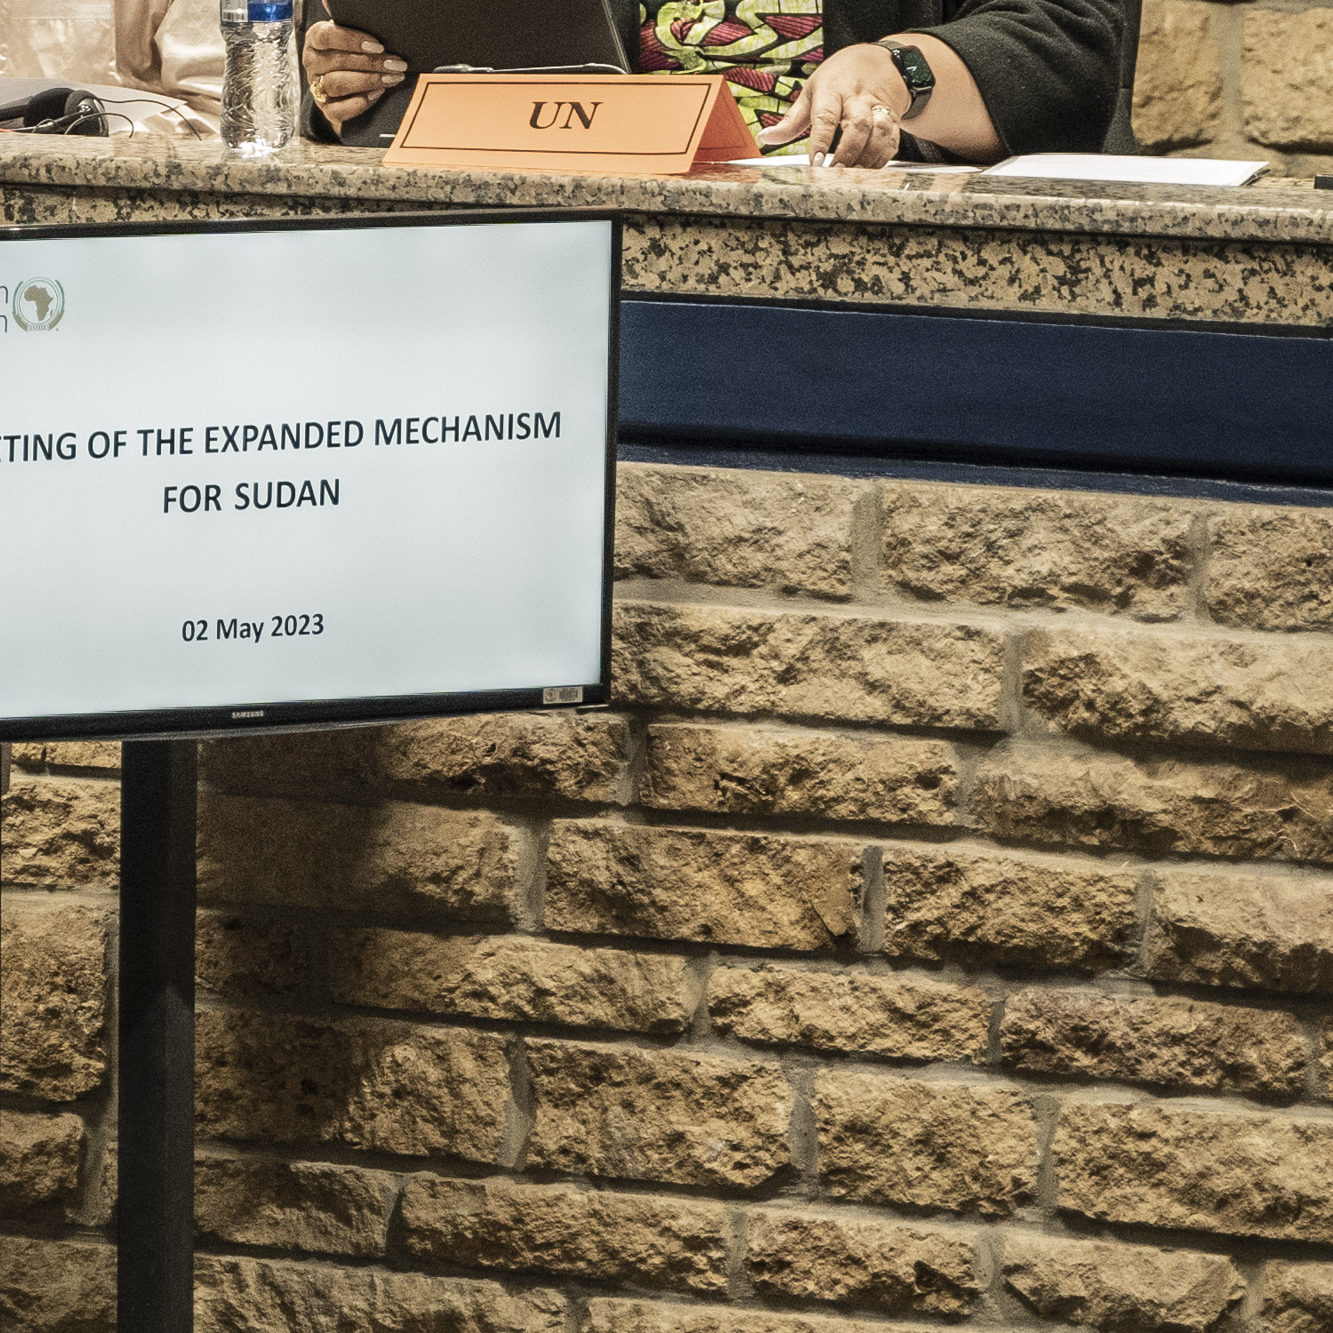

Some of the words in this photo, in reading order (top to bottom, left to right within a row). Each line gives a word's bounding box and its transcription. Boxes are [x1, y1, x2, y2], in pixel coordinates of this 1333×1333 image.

[529, 101, 602, 130] UN
[87, 430, 128, 459] OF
[136, 427, 194, 457] THE
[205, 420, 364, 454] EXPANDED
[374, 411, 561, 446] MECHANISM
[163, 484, 222, 514] FOR
[234, 478, 340, 511] SUDAN
[181, 619, 208, 642] 02
[216, 618, 265, 644] May
[271, 613, 324, 637] 2023
